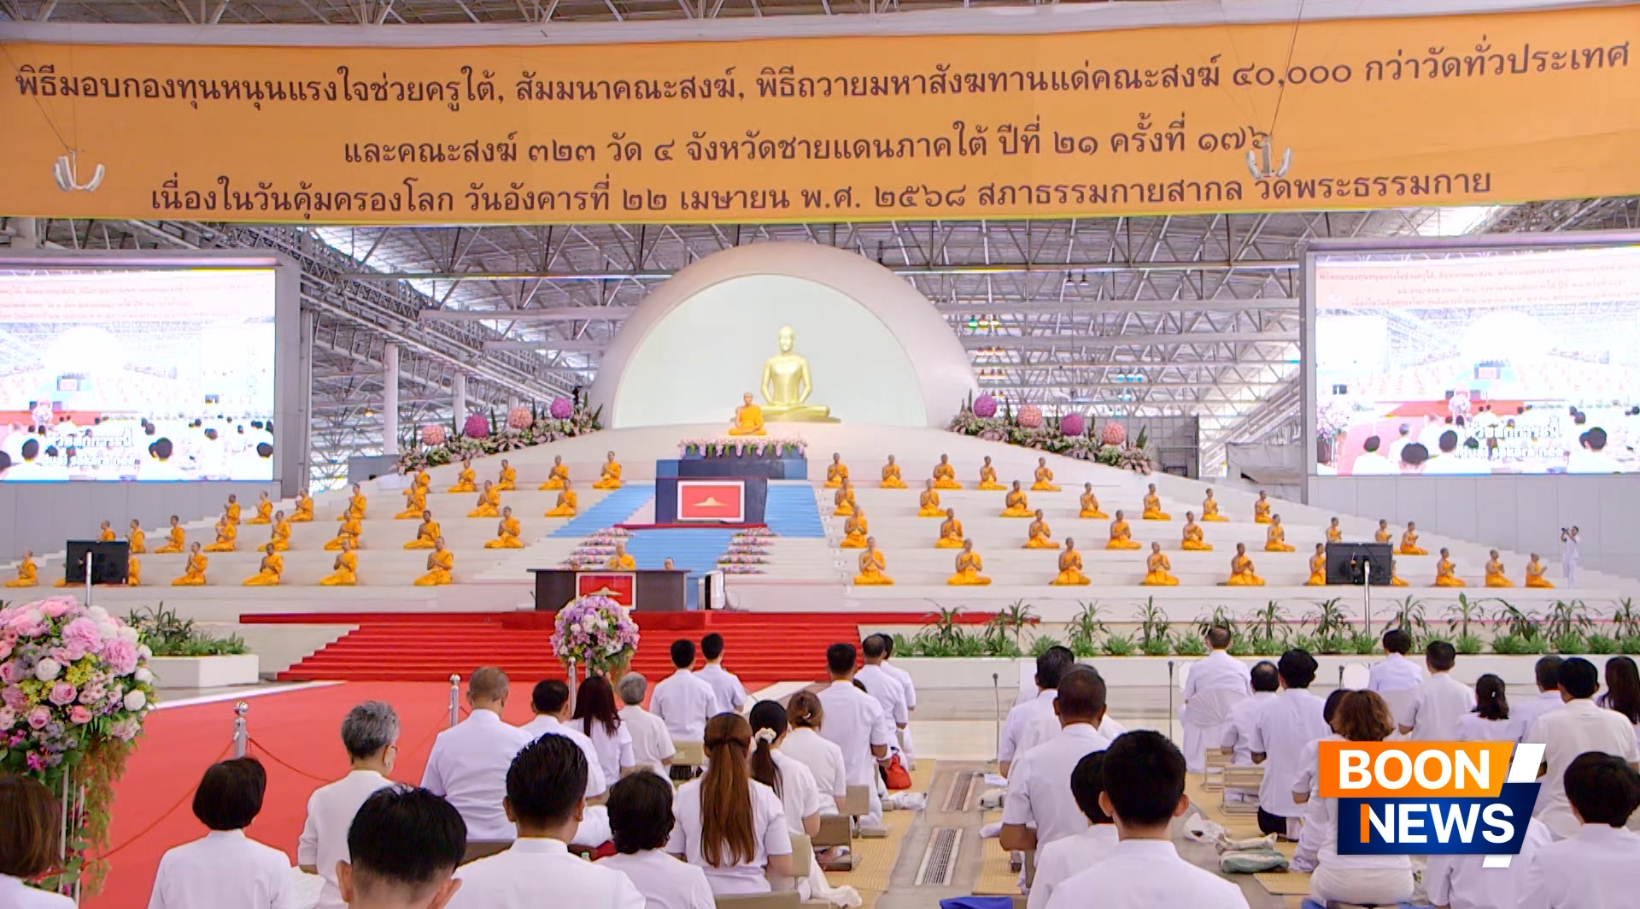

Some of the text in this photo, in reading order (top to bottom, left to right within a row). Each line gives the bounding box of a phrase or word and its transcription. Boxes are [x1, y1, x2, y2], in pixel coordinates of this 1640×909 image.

[14, 34, 1631, 111] พิธีมอบกองทุนหนุนแรงใจช่วยครูใต้, สัมมนาคณะสงฆ์, พิธีถวายมหาสังฆทานแด่คณะสงฆ์ ๔๐,๐๐๐ กว่าวัดทั่วประเทศ
[344, 131, 518, 163] และคณะสงฆ์
[528, 138, 597, 162] ๓๒๓
[606, 131, 643, 162] วัด
[653, 138, 677, 162] ๔
[685, 120, 990, 161] จังหวัดชายแดนภาคใต้
[996, 114, 1041, 156] ปีที่
[1052, 130, 1099, 156] ๒๑
[1109, 111, 1187, 153] ครั้งที่
[151, 168, 1491, 220] เนื่องในวันคุ้มครองโลก วันอังคารที่ ๒๒ เมษายน พ.ศ. ๒๕๖๘ สภาธรรมกายสากล วดพระธรรมกาย
